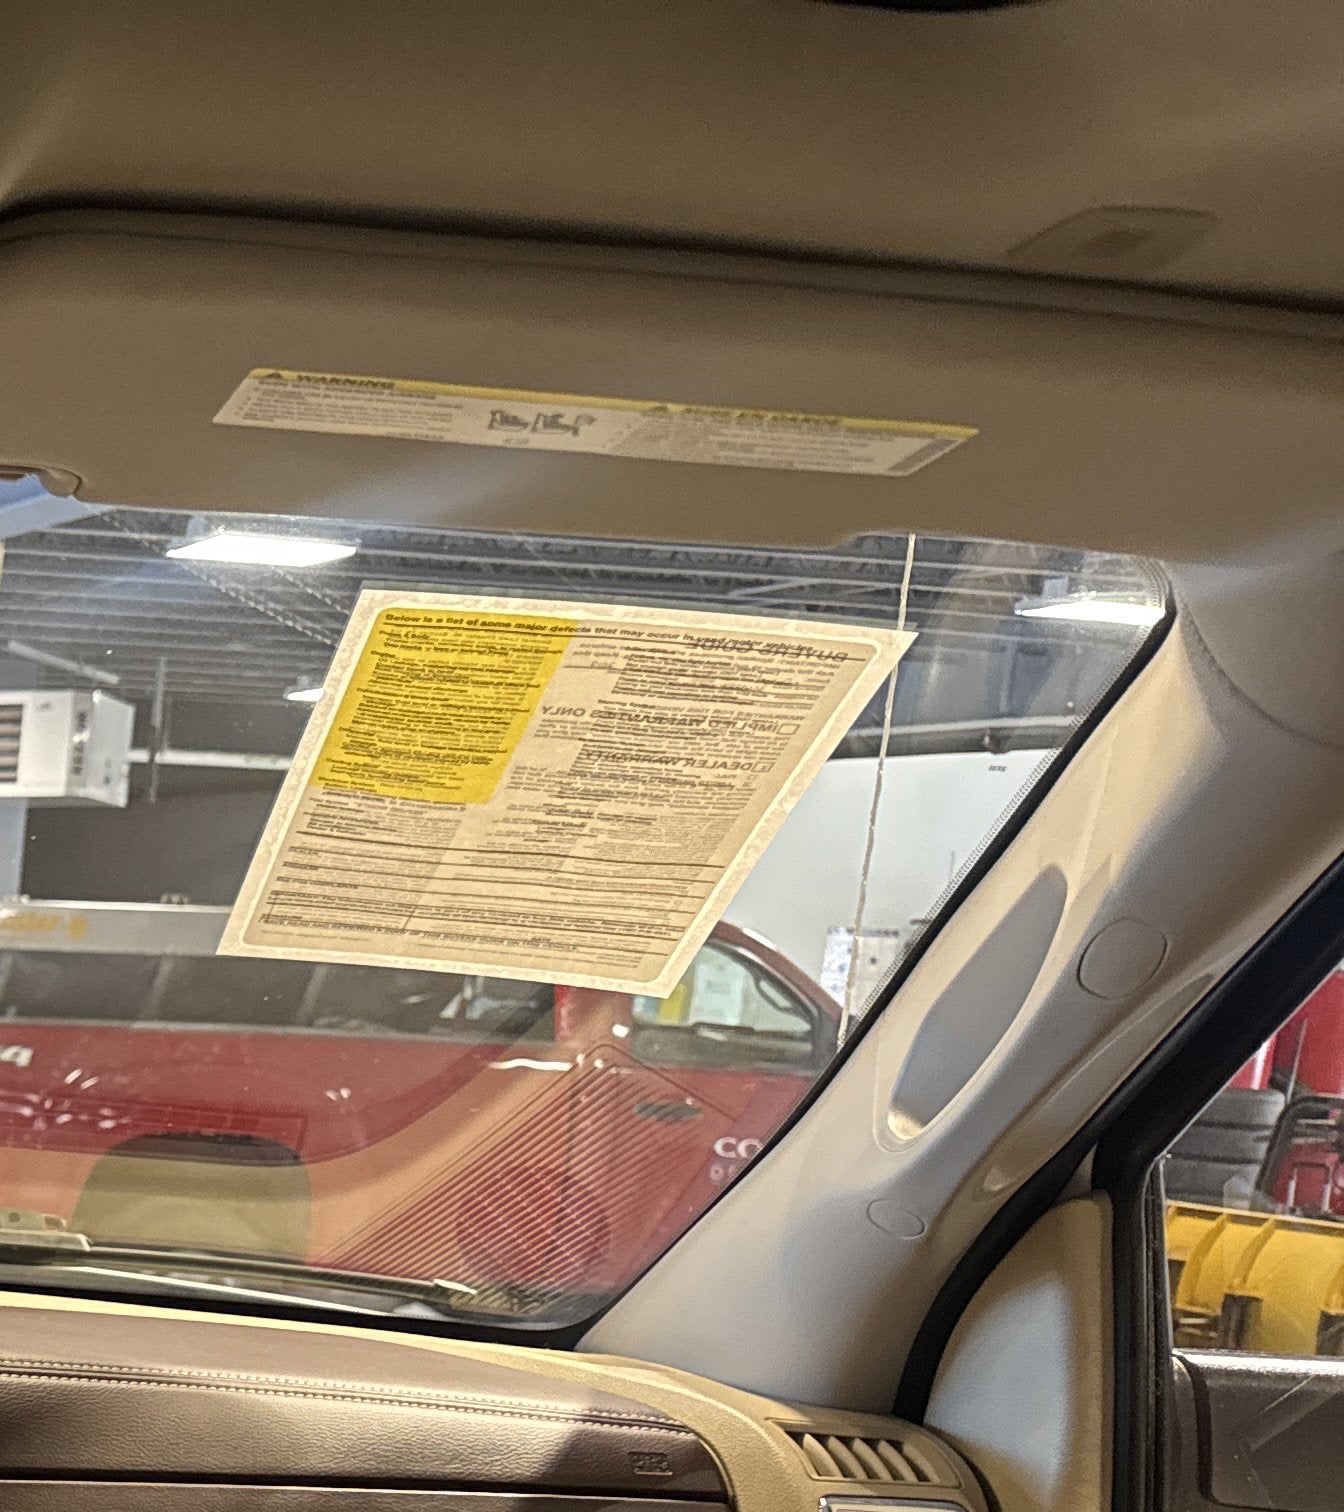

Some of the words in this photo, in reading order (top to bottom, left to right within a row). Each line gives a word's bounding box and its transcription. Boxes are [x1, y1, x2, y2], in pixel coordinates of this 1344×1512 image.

[385, 613, 421, 623] Below
[446, 617, 465, 625] list
[480, 621, 512, 629] some
[515, 622, 548, 632] major
[550, 624, 592, 633] defects
[595, 627, 617, 635] that
[620, 629, 644, 638] may
[647, 632, 680, 640] occur
